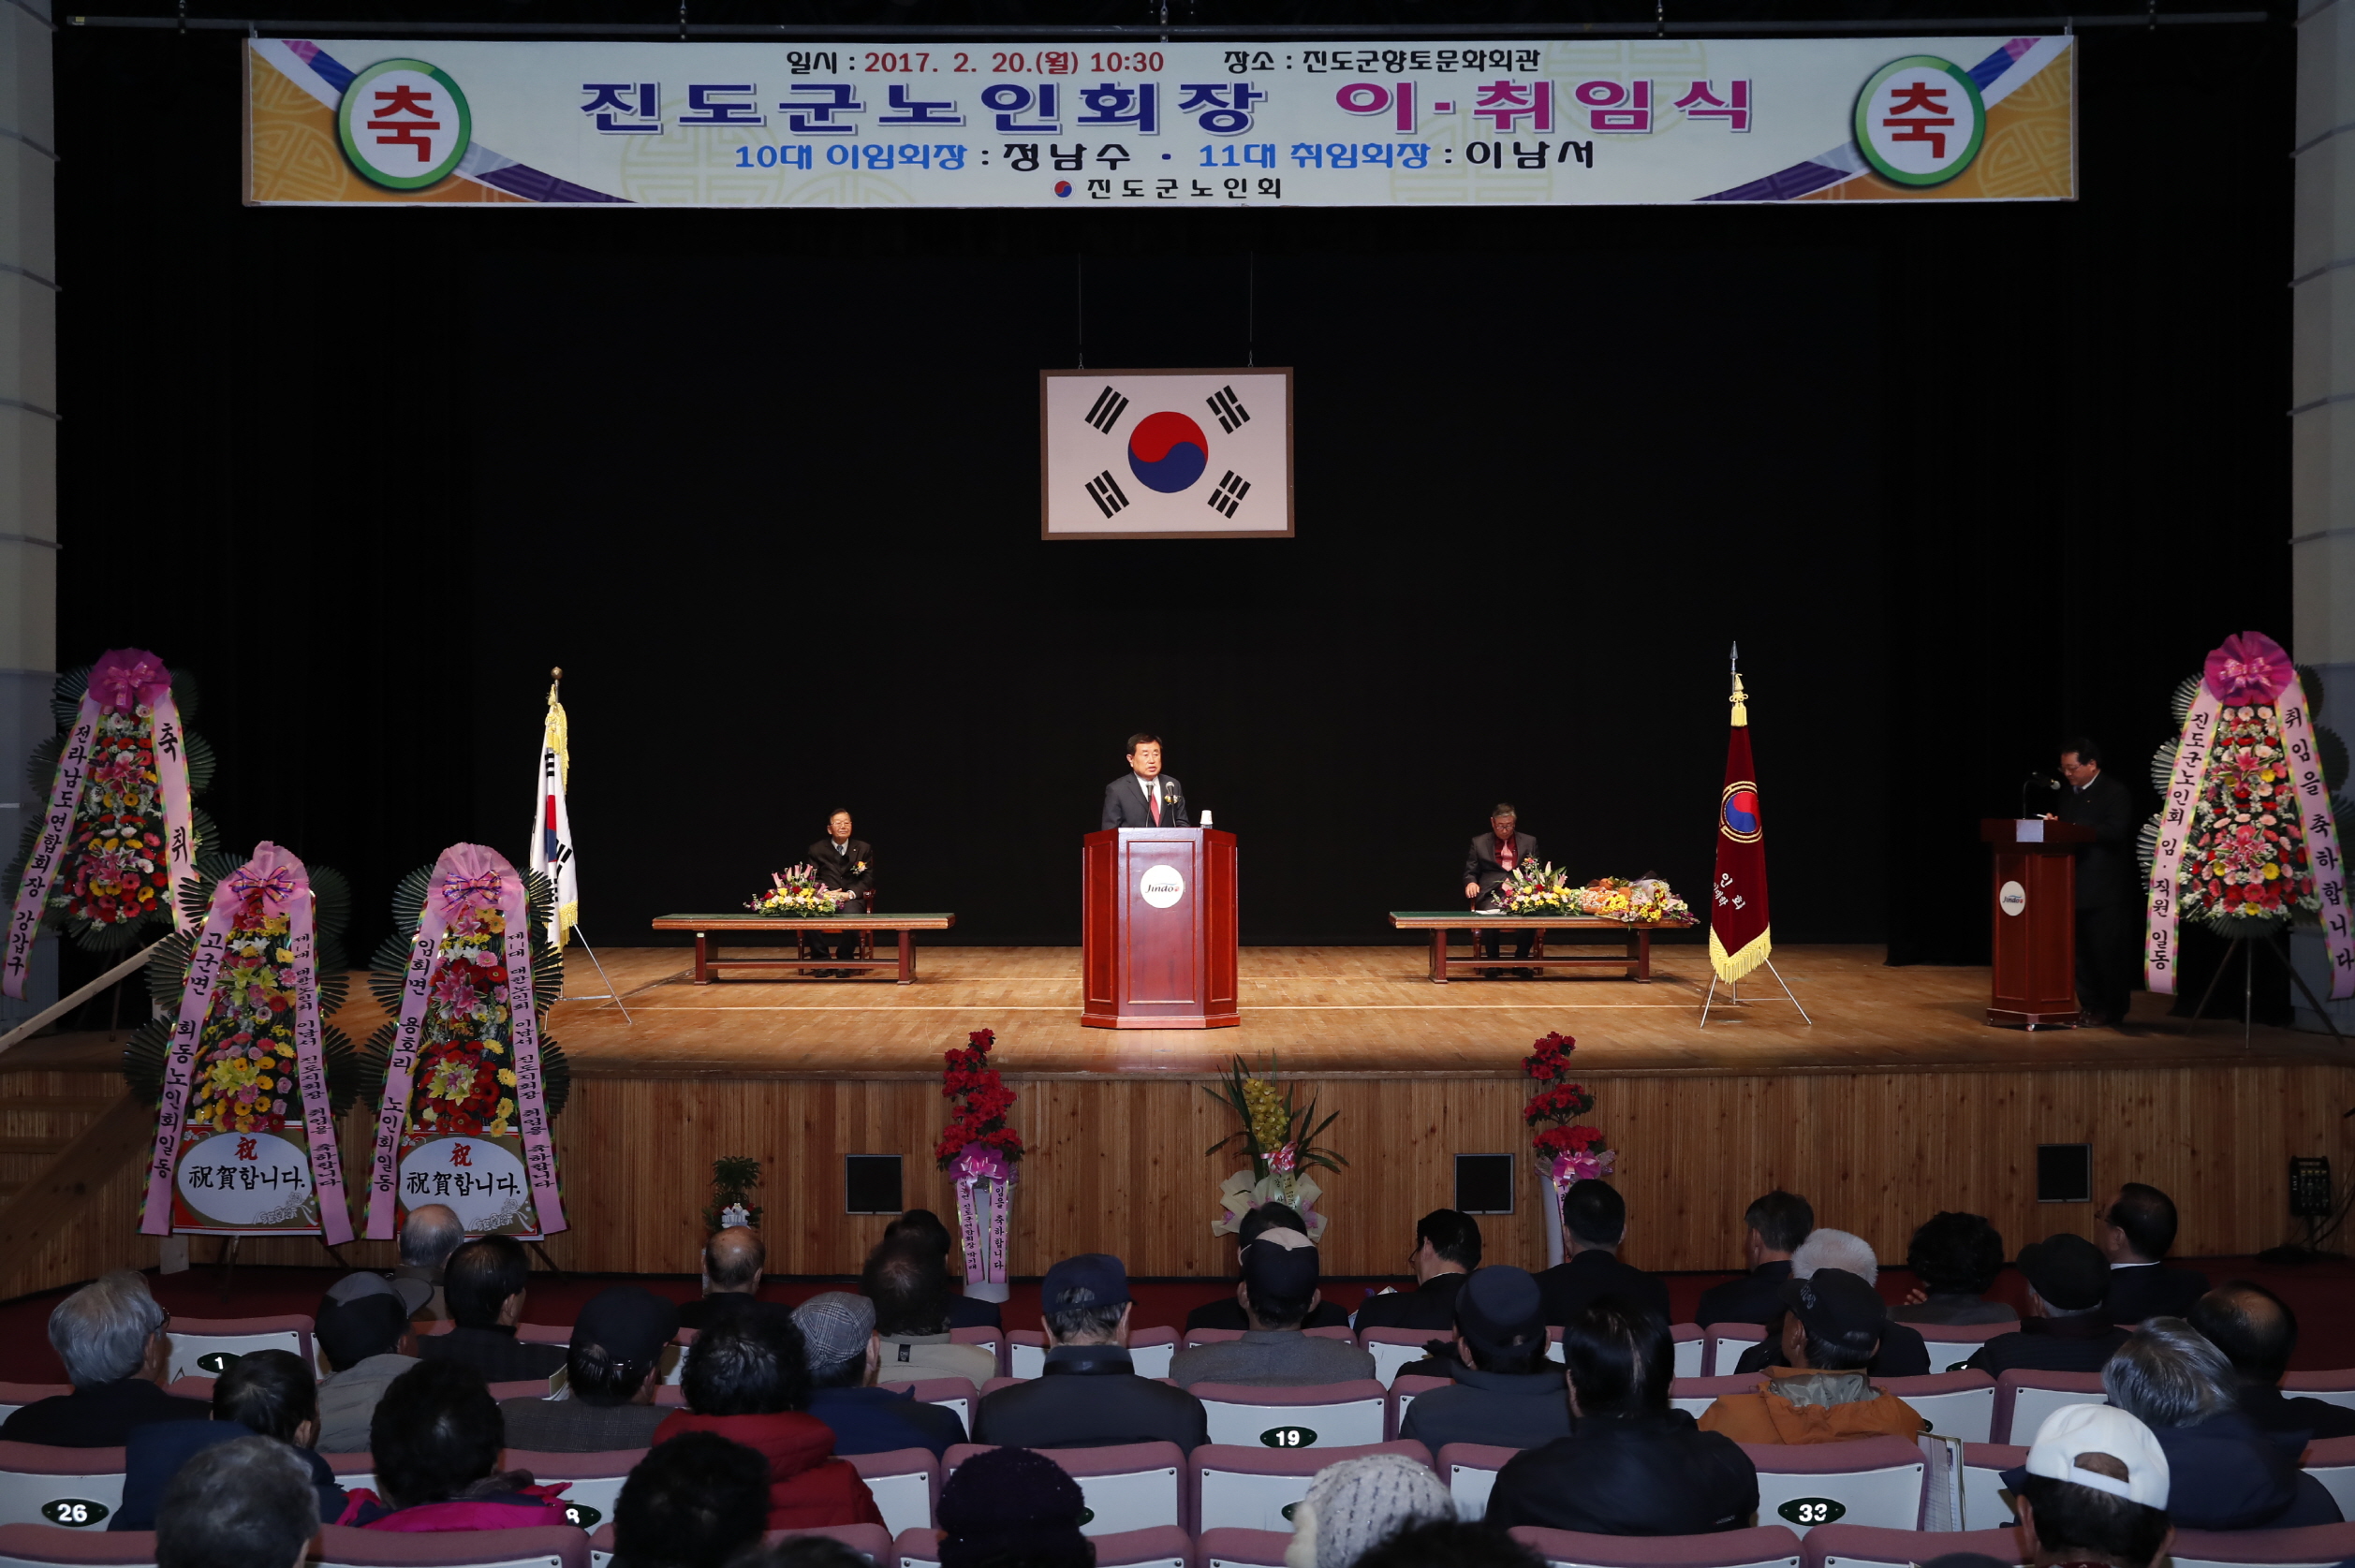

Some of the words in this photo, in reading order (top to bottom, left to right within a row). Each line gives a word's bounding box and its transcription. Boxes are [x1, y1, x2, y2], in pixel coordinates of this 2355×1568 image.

[786, 51, 838, 75] 일시
[863, 51, 938, 73] 2017.
[952, 53, 978, 73] 2.
[1090, 51, 1165, 73] 10:30
[1223, 50, 1275, 75] 장소
[1302, 49, 1541, 74] 진도군향토문화회관
[366, 83, 443, 163] 축
[580, 81, 1265, 135] 진도군노인회장
[1882, 81, 1956, 159] 축
[734, 143, 813, 170] 10대
[826, 143, 968, 170] 이임회장
[1002, 141, 1131, 171] 정남수
[1199, 142, 1276, 169] 11대
[1289, 141, 1432, 169] 취임회장
[1465, 140, 1594, 169] 이남서
[1086, 177, 1282, 199] 진도군노인회
[2167, 711, 2210, 827] 진도군노인회
[157, 723, 179, 763] 축
[170, 826, 189, 864] 취
[2282, 707, 2320, 797] 취임을
[2308, 813, 2355, 972] 축하합니다
[7, 909, 36, 977] 강갑구
[189, 932, 224, 997] 고군면
[2148, 929, 2171, 972] 일동
[296, 967, 315, 1012] 대한노인회
[408, 937, 437, 997] 임회면
[509, 966, 532, 1011] 대한노인회
[297, 1019, 319, 1047] 이남서
[390, 1016, 422, 1077] 용호리
[514, 1018, 535, 1046] 이남서
[233, 1136, 259, 1162] 祝
[312, 1142, 342, 1187] 축하합니다
[449, 1141, 474, 1168] 祝
[527, 1144, 556, 1189] 축하합니다
[994, 1186, 1006, 1209] 임을
[1273, 1429, 1302, 1447] 19
[57, 1502, 89, 1524] 26
